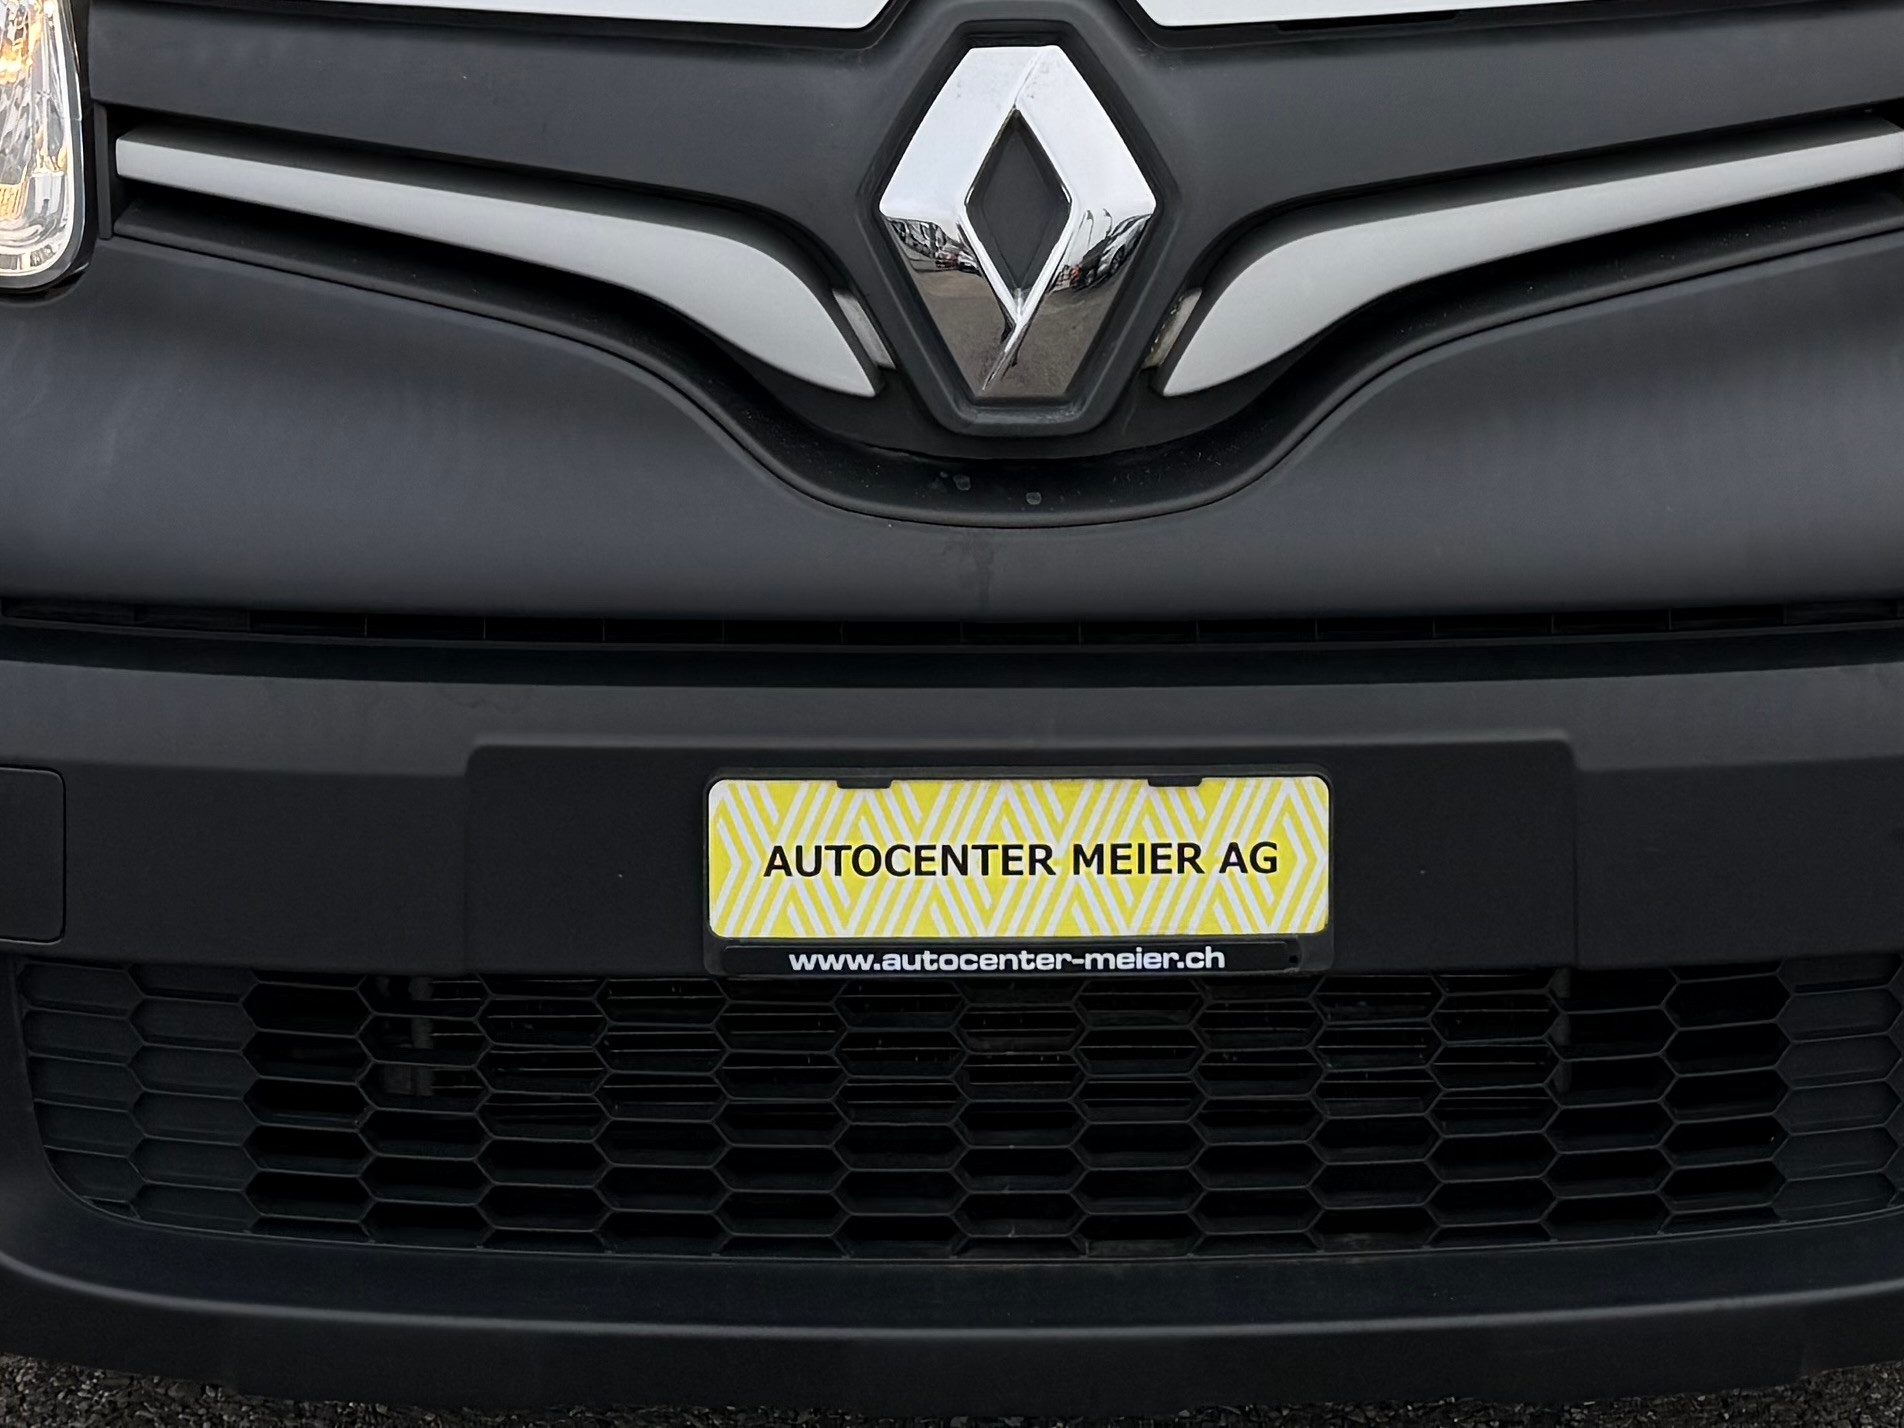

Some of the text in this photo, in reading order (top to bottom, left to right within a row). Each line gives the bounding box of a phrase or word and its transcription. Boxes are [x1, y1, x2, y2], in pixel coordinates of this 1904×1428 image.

[762, 840, 1280, 878] AUTOCENTER MEIER AG
[788, 945, 1227, 973] www.autocenter-meier.ch
